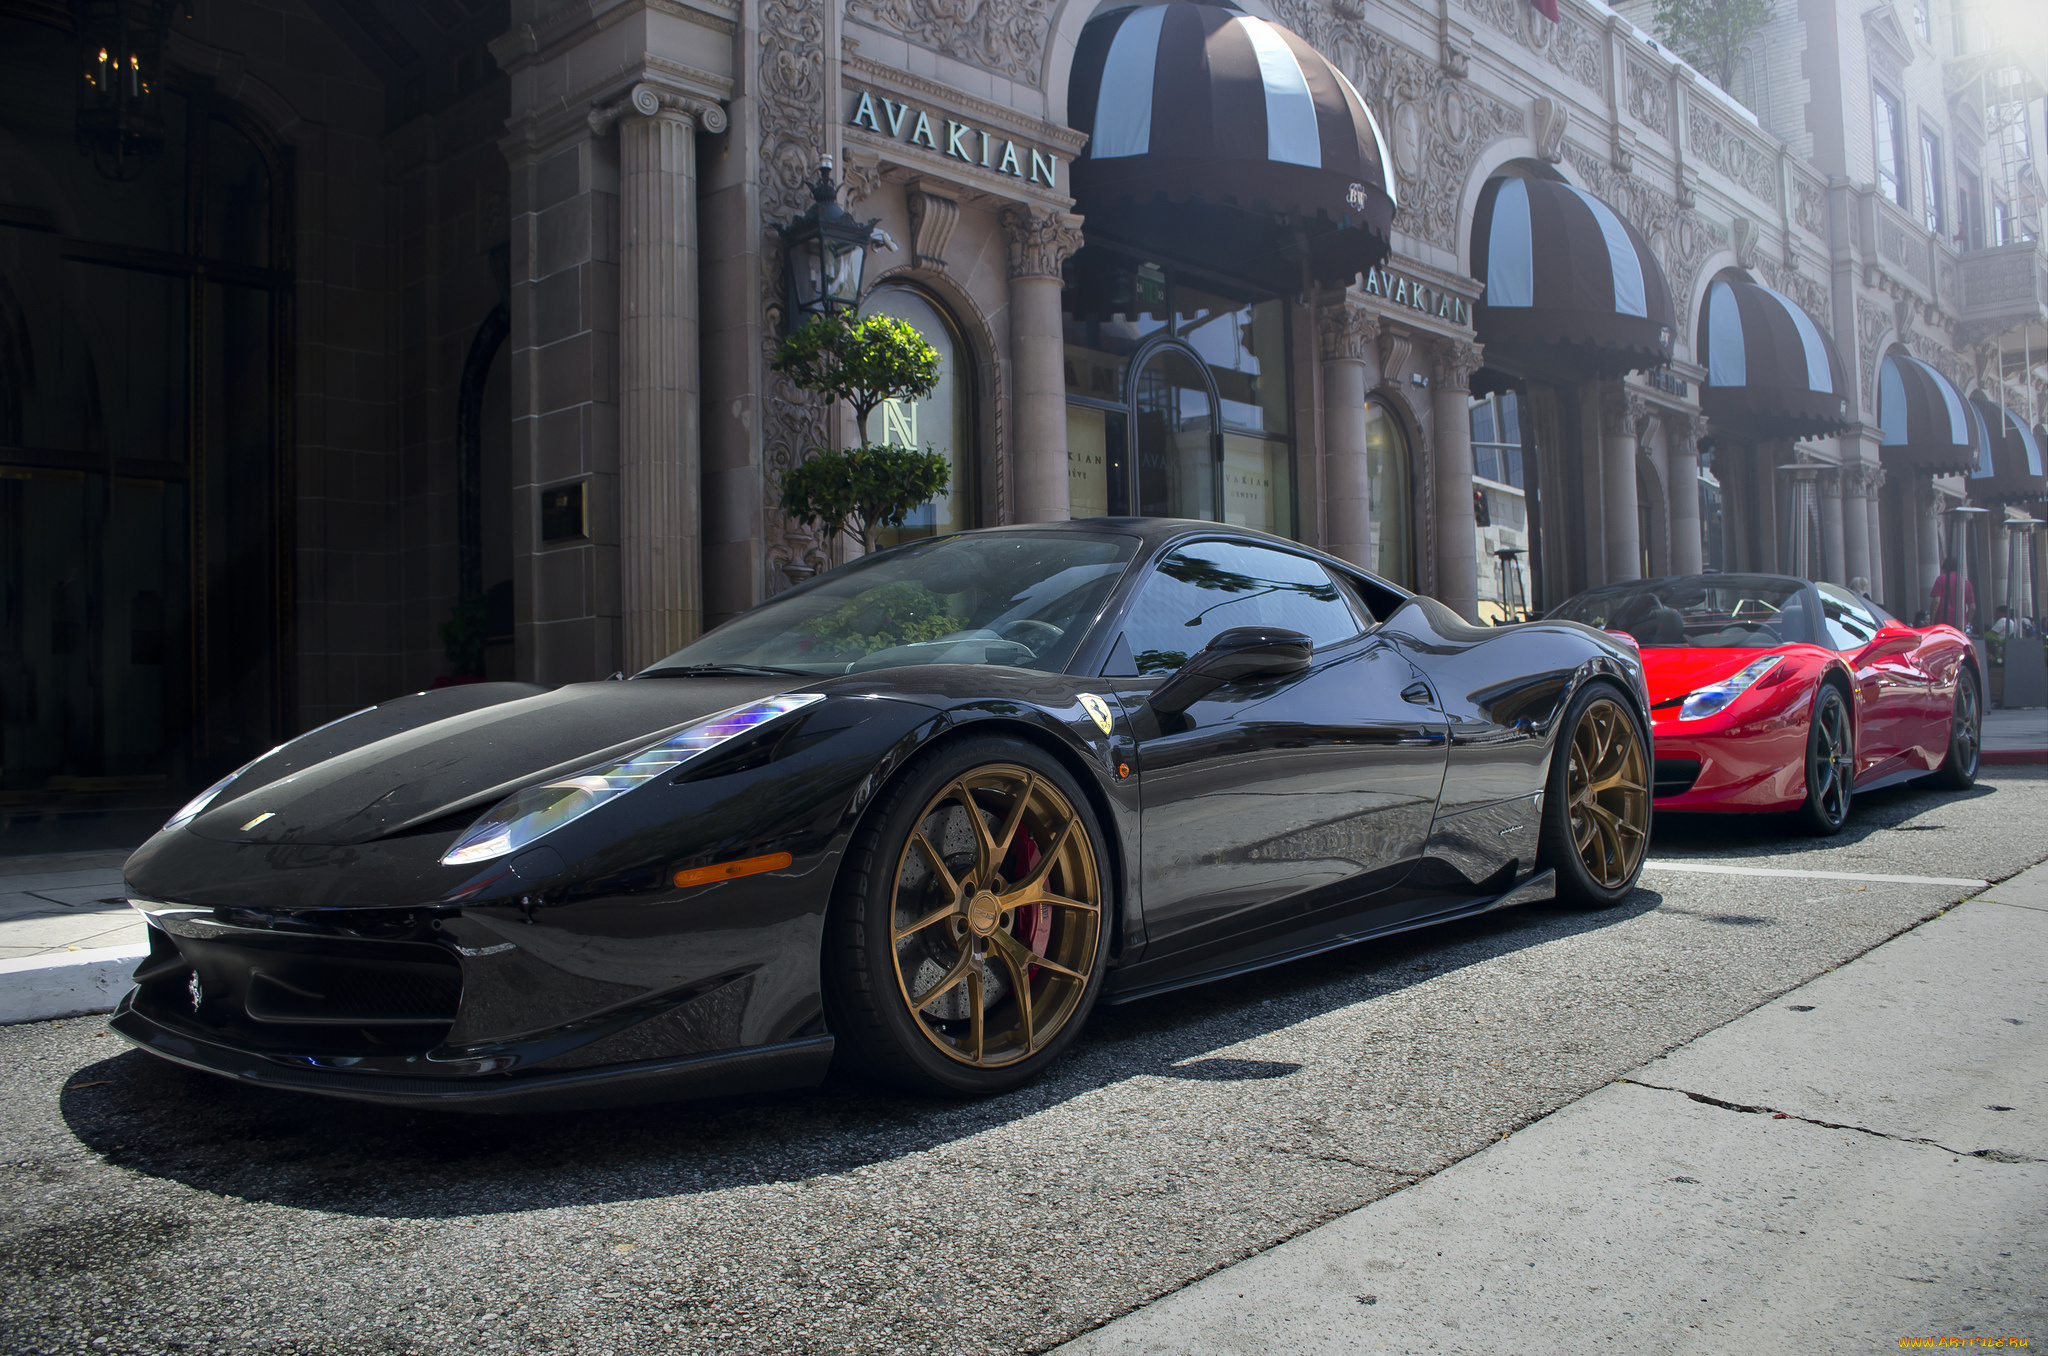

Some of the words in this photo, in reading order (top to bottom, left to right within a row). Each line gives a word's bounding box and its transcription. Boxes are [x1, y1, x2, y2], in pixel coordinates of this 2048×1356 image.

[851, 91, 1059, 188] AVAKIAN
[1365, 265, 1468, 326] AVAKIAN
[1067, 451, 1102, 465] KIAN
[1225, 474, 1270, 488] VAKIAN
